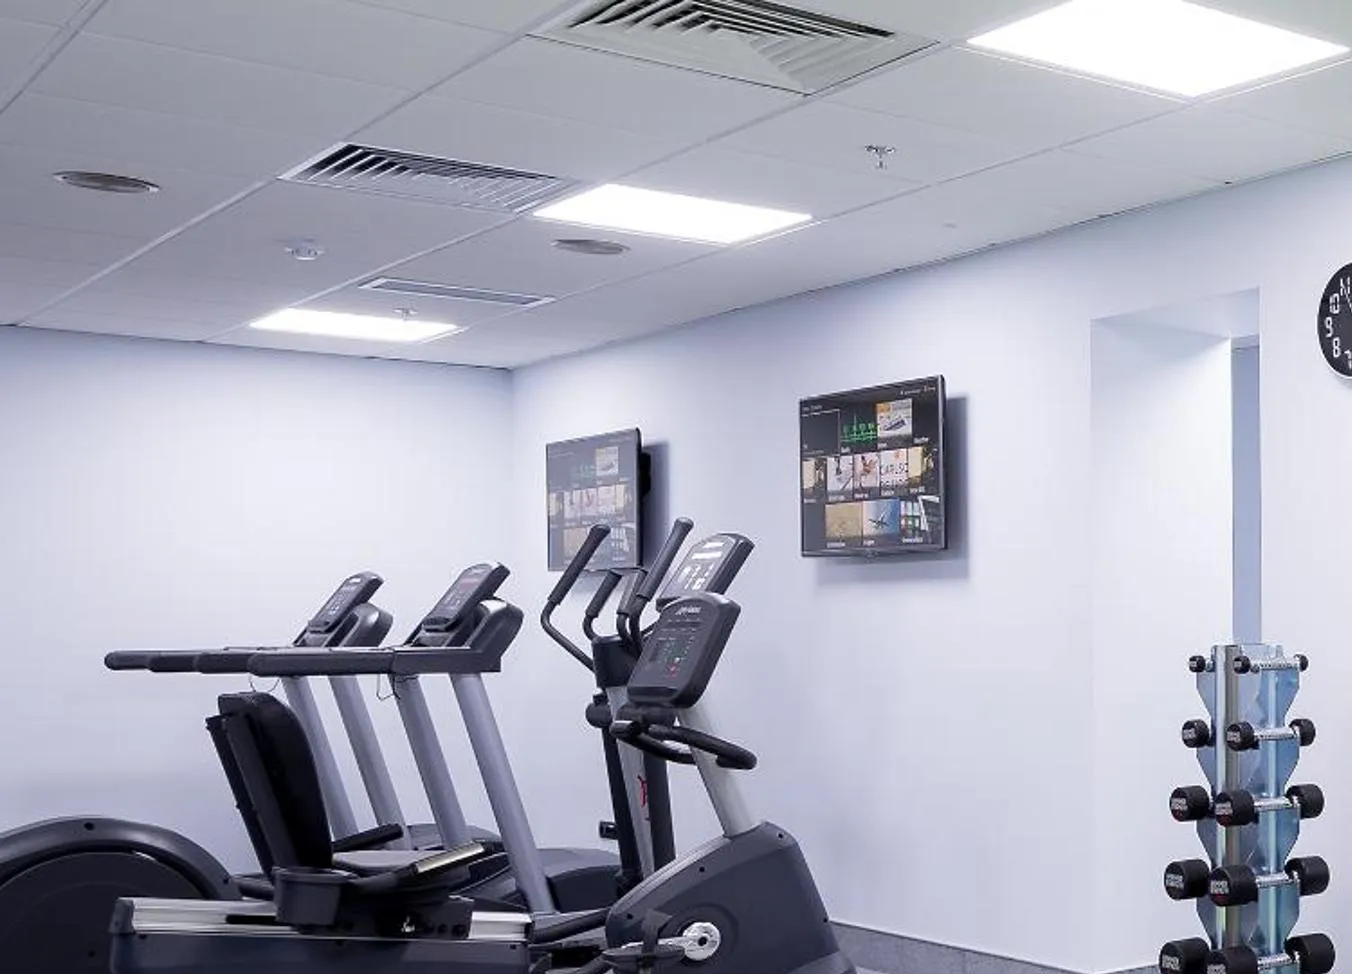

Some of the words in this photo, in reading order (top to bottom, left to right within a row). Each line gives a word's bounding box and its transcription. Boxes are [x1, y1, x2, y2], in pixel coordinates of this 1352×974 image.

[1329, 293, 1340, 314] 10
[1324, 316, 1333, 338] 9
[1332, 337, 1340, 358] 8
[1344, 349, 1352, 370] 7
